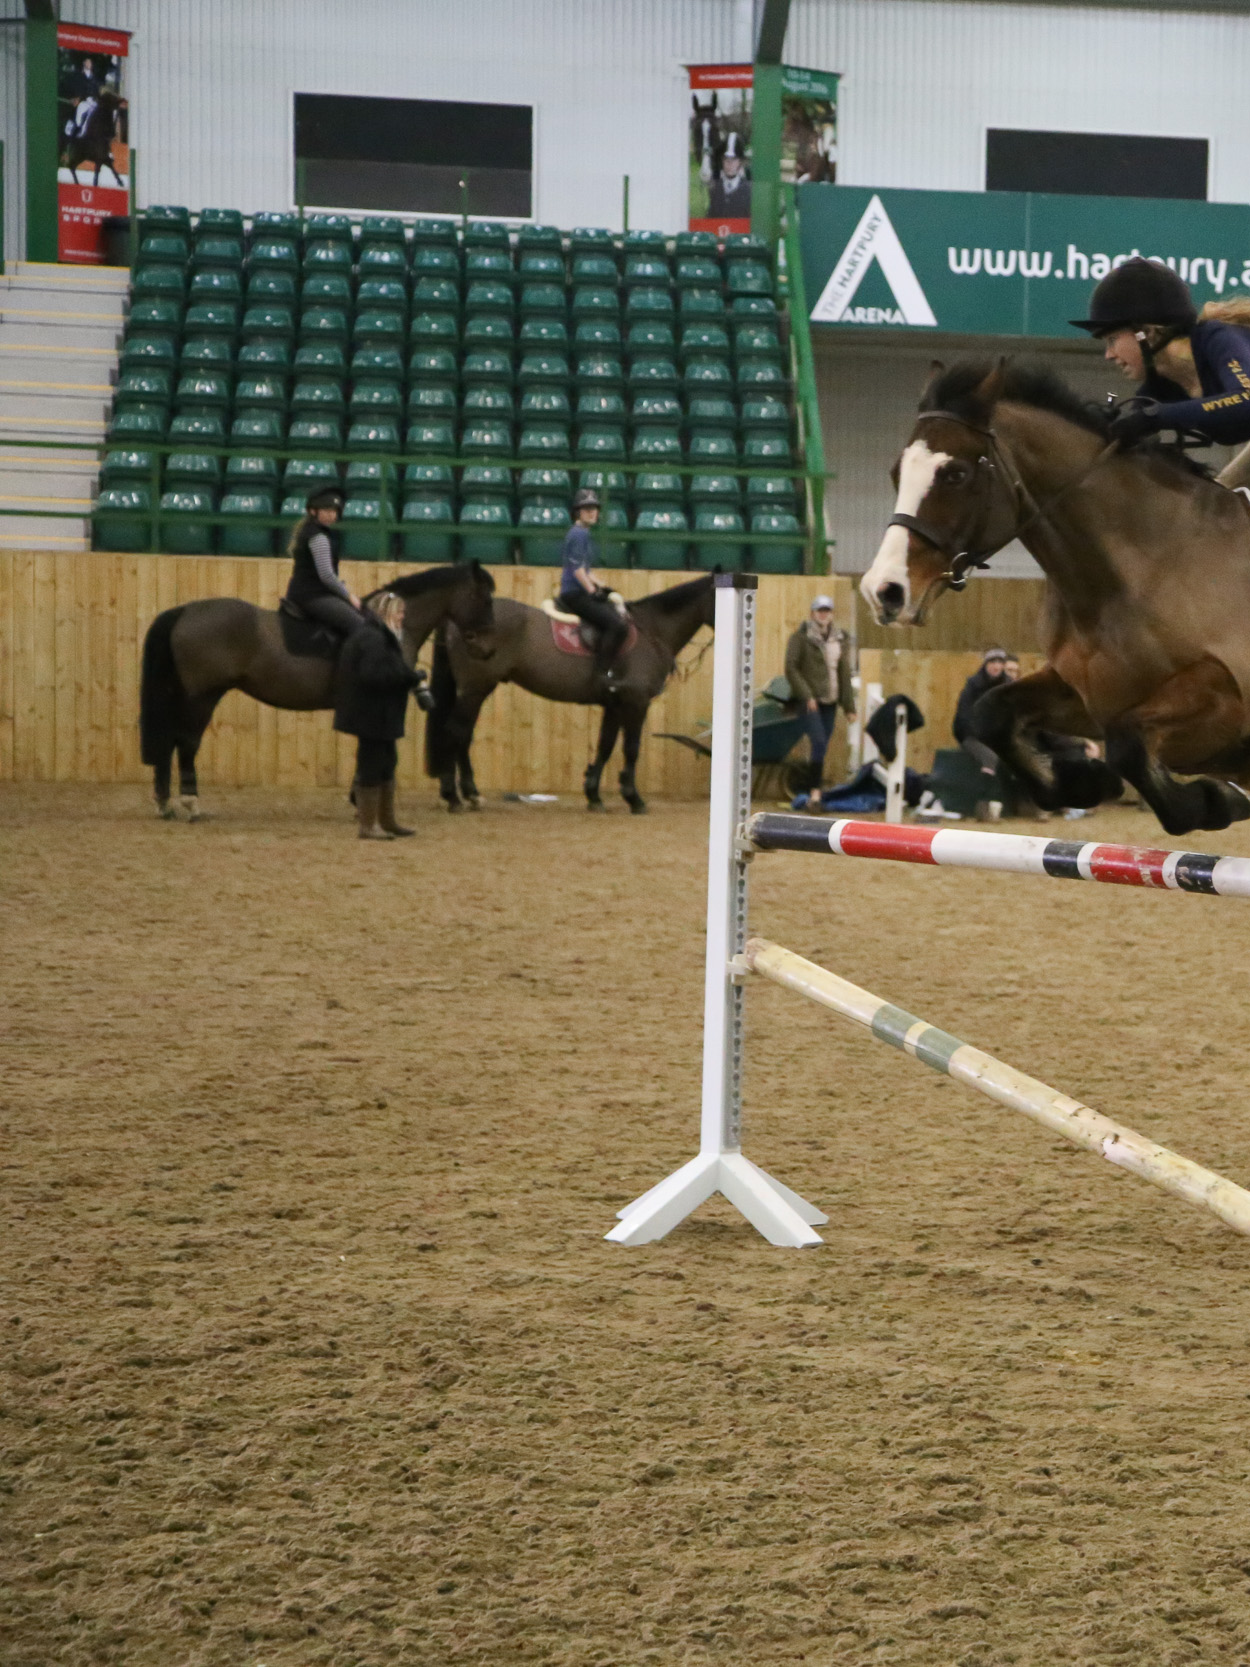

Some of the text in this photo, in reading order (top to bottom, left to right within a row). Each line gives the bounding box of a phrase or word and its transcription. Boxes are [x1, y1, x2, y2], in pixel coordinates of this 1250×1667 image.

[61, 205, 112, 218] HARTPURY
[63, 213, 103, 226] SPOR
[821, 213, 882, 315] THE HARTPURY
[841, 306, 906, 325] ARENA
[1201, 393, 1243, 412] WYRE
